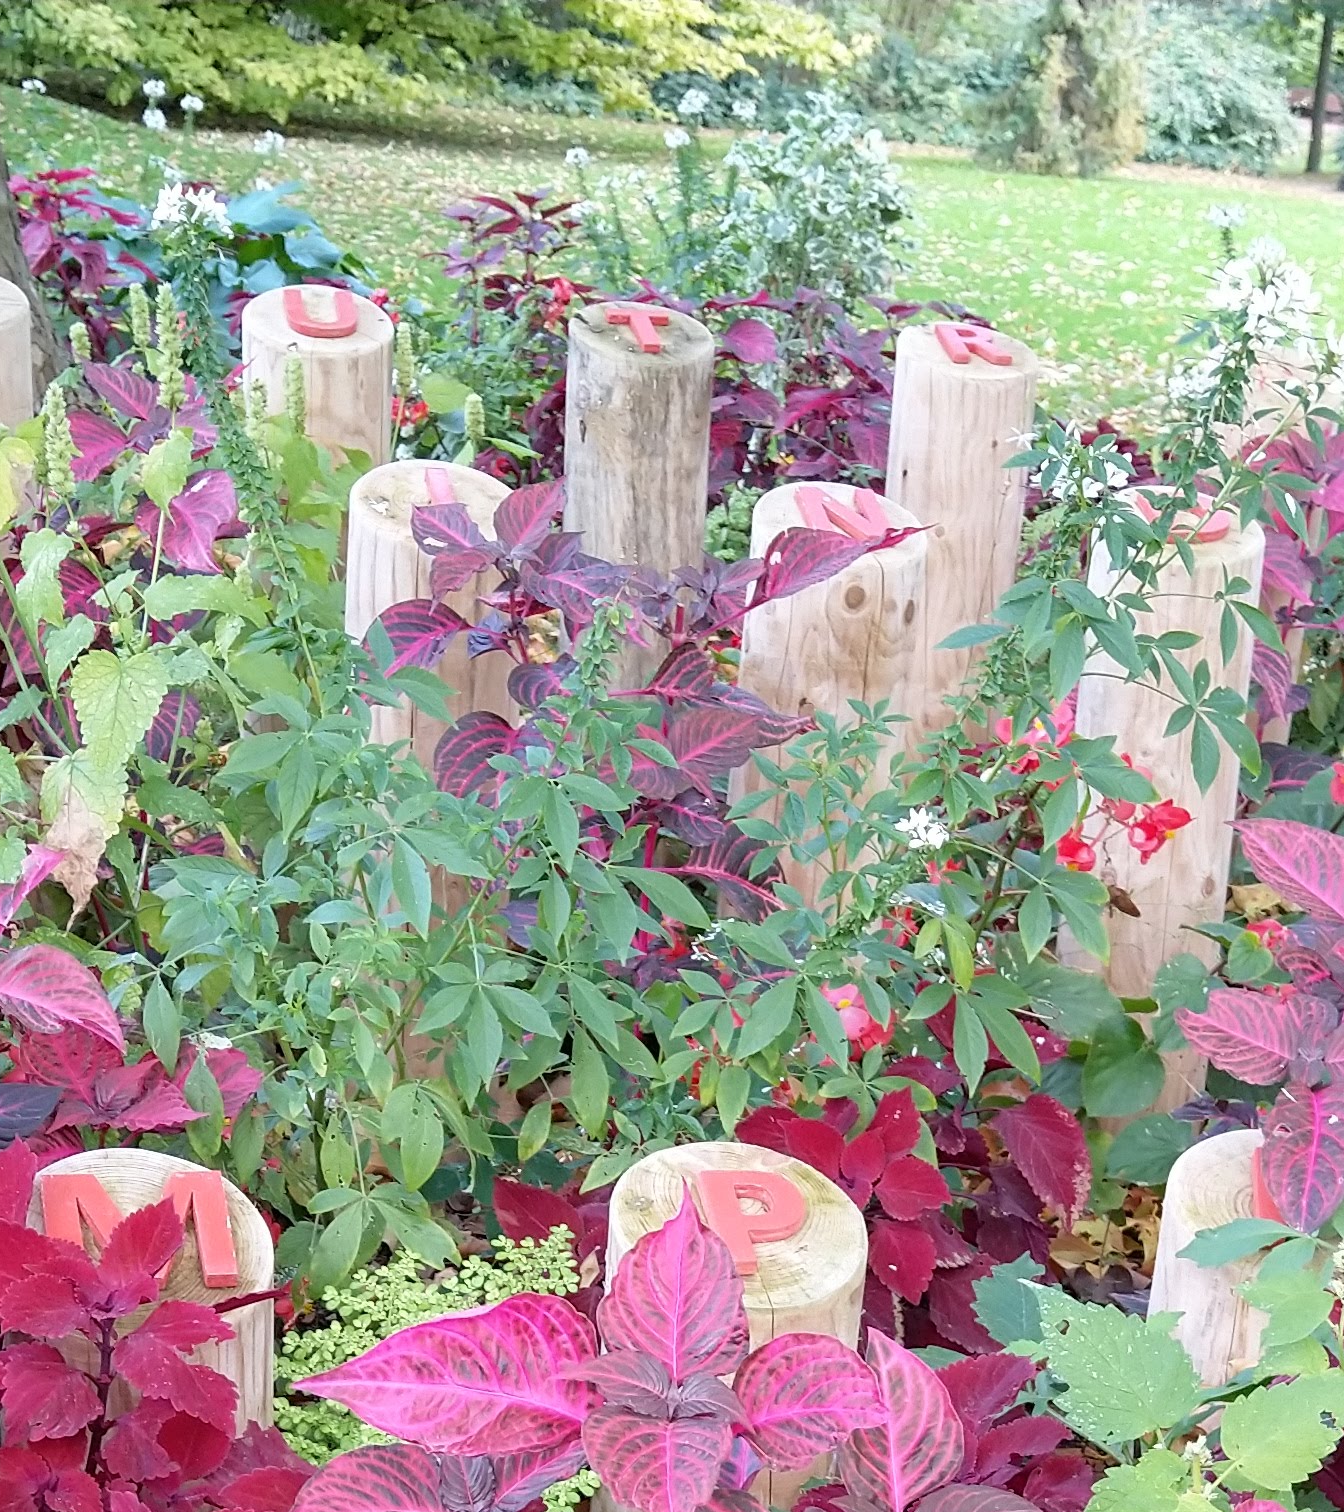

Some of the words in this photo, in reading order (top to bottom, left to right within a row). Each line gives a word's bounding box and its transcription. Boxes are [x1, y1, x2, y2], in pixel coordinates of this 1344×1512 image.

[283, 288, 357, 338] U
[605, 308, 670, 353] T
[934, 314, 1013, 366] R
[700, 1170, 806, 1276] P
